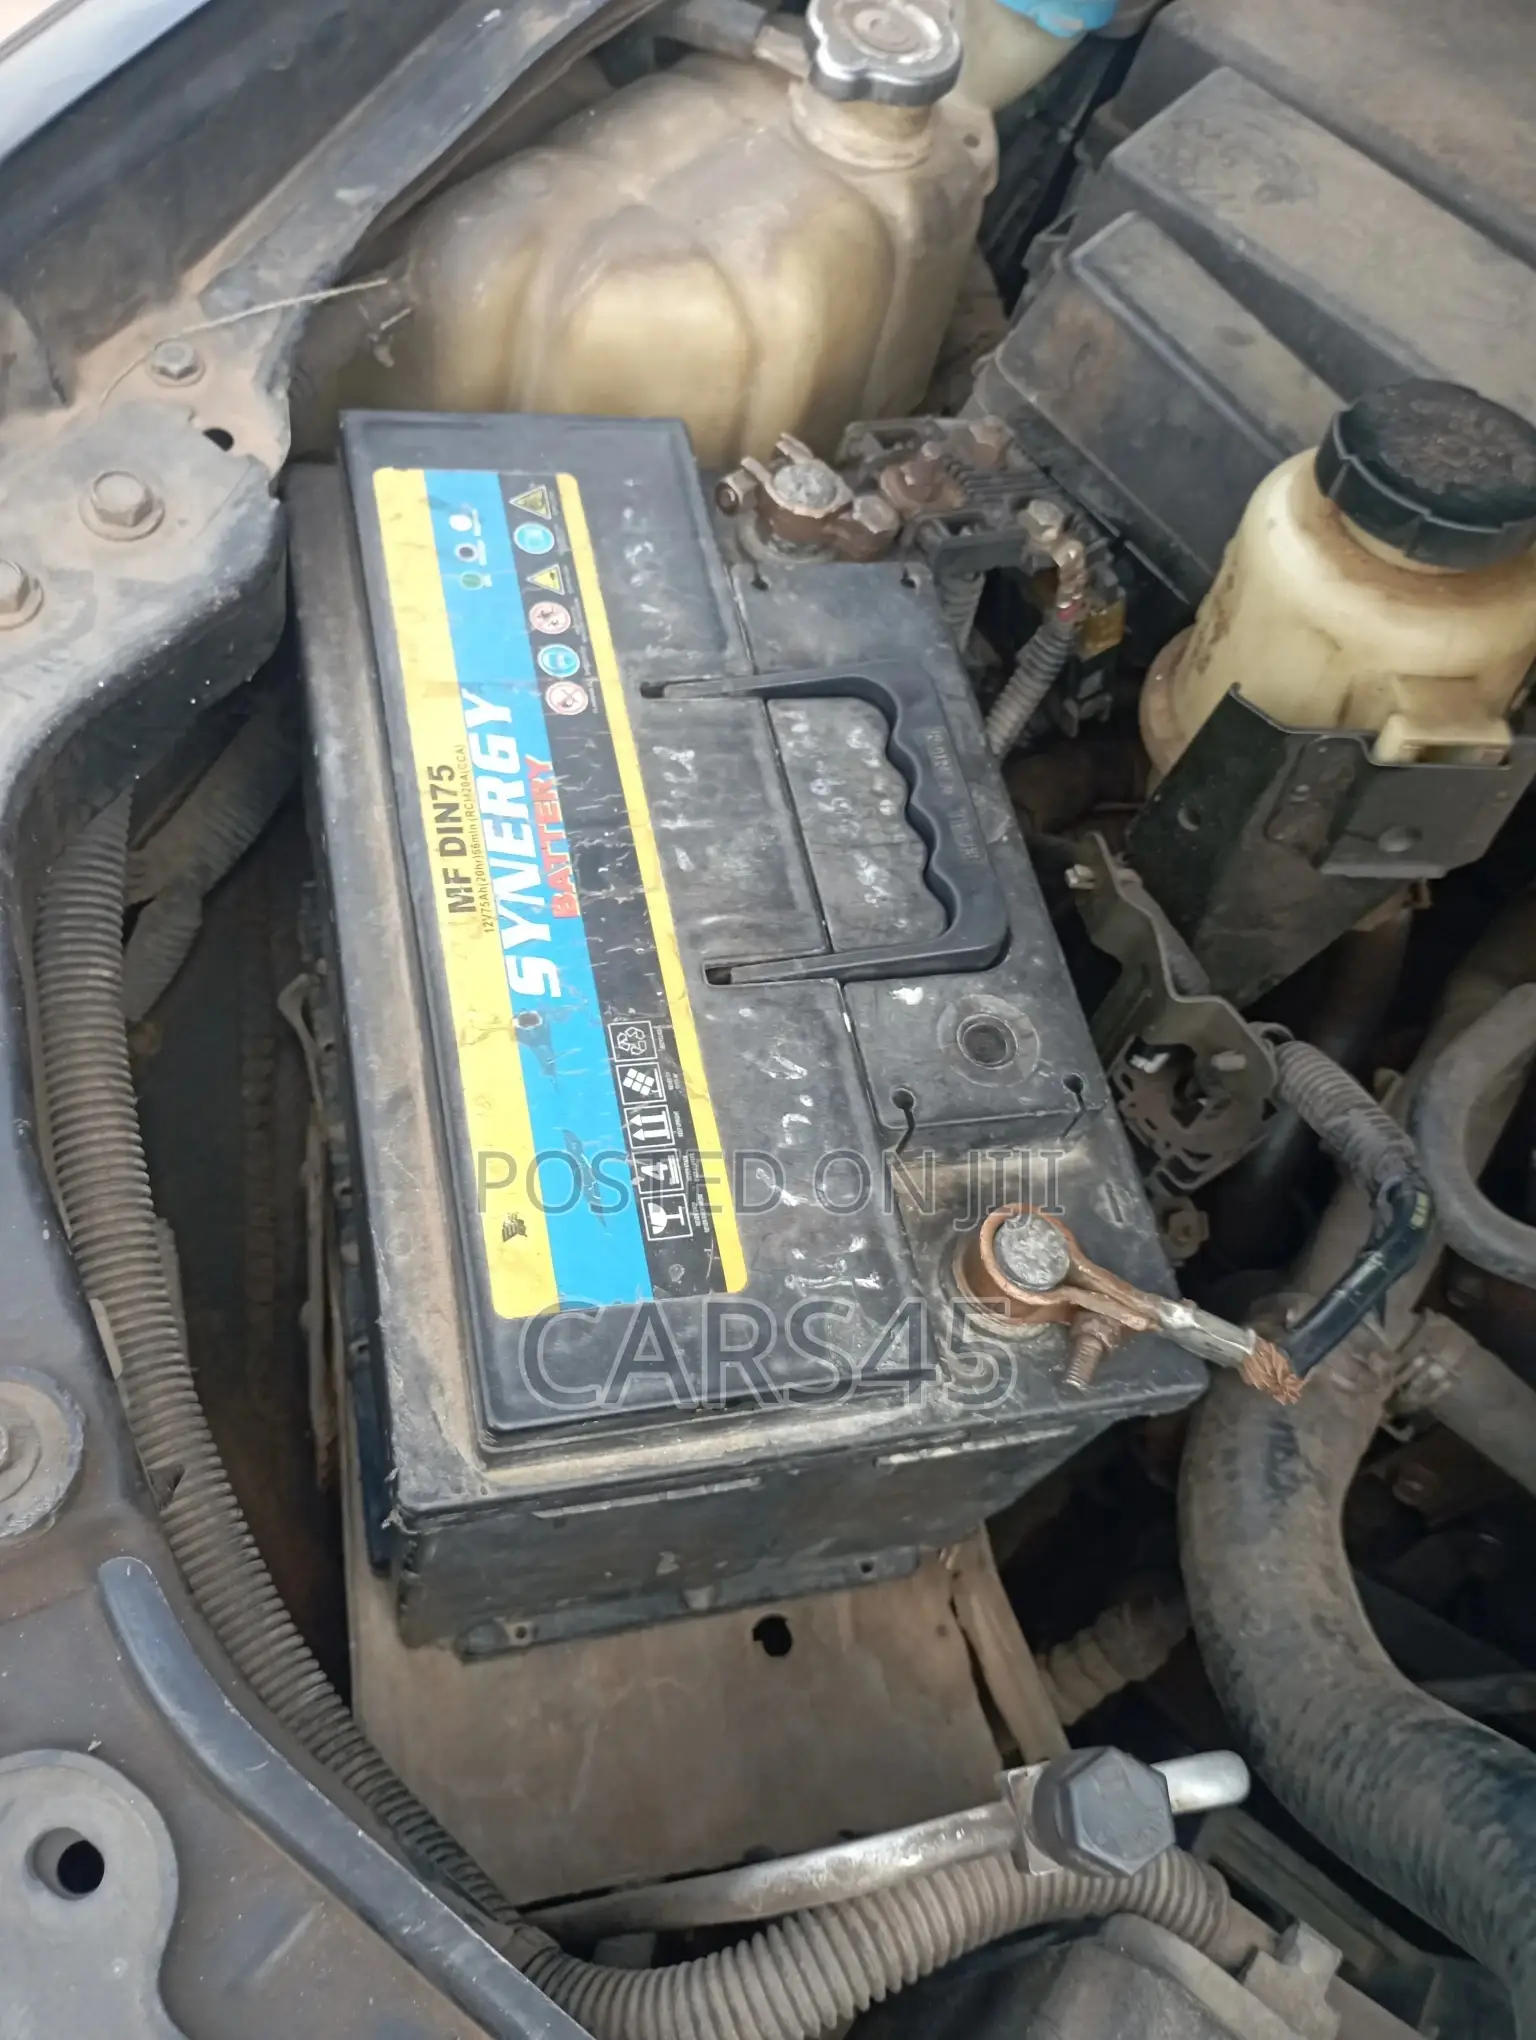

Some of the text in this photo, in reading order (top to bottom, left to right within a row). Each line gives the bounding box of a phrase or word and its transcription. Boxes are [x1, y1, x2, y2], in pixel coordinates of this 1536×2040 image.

[427, 764, 477, 913] MF DIN75
[461, 687, 562, 998] SYNERGY
[524, 754, 581, 918] BATTERY
